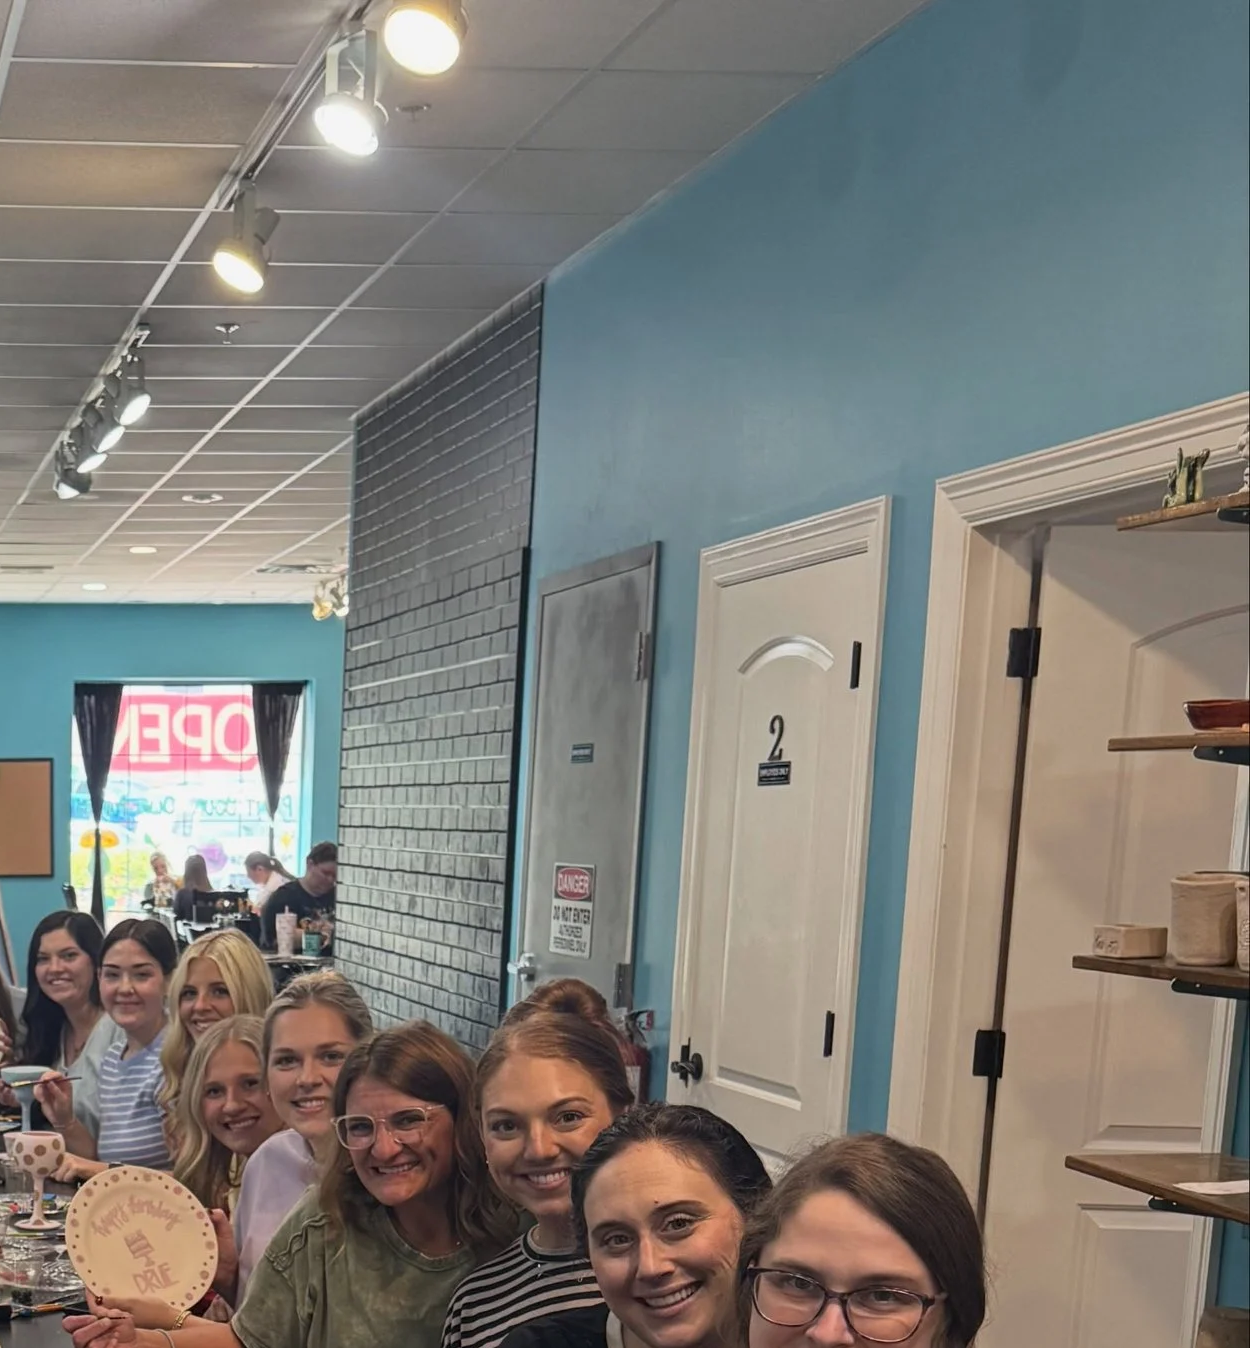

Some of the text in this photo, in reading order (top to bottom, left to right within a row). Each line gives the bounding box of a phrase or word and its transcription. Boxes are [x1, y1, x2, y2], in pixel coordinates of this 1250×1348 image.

[768, 714, 784, 761] 2
[557, 873, 590, 894] DANGER
[573, 907, 591, 925] ENTER
